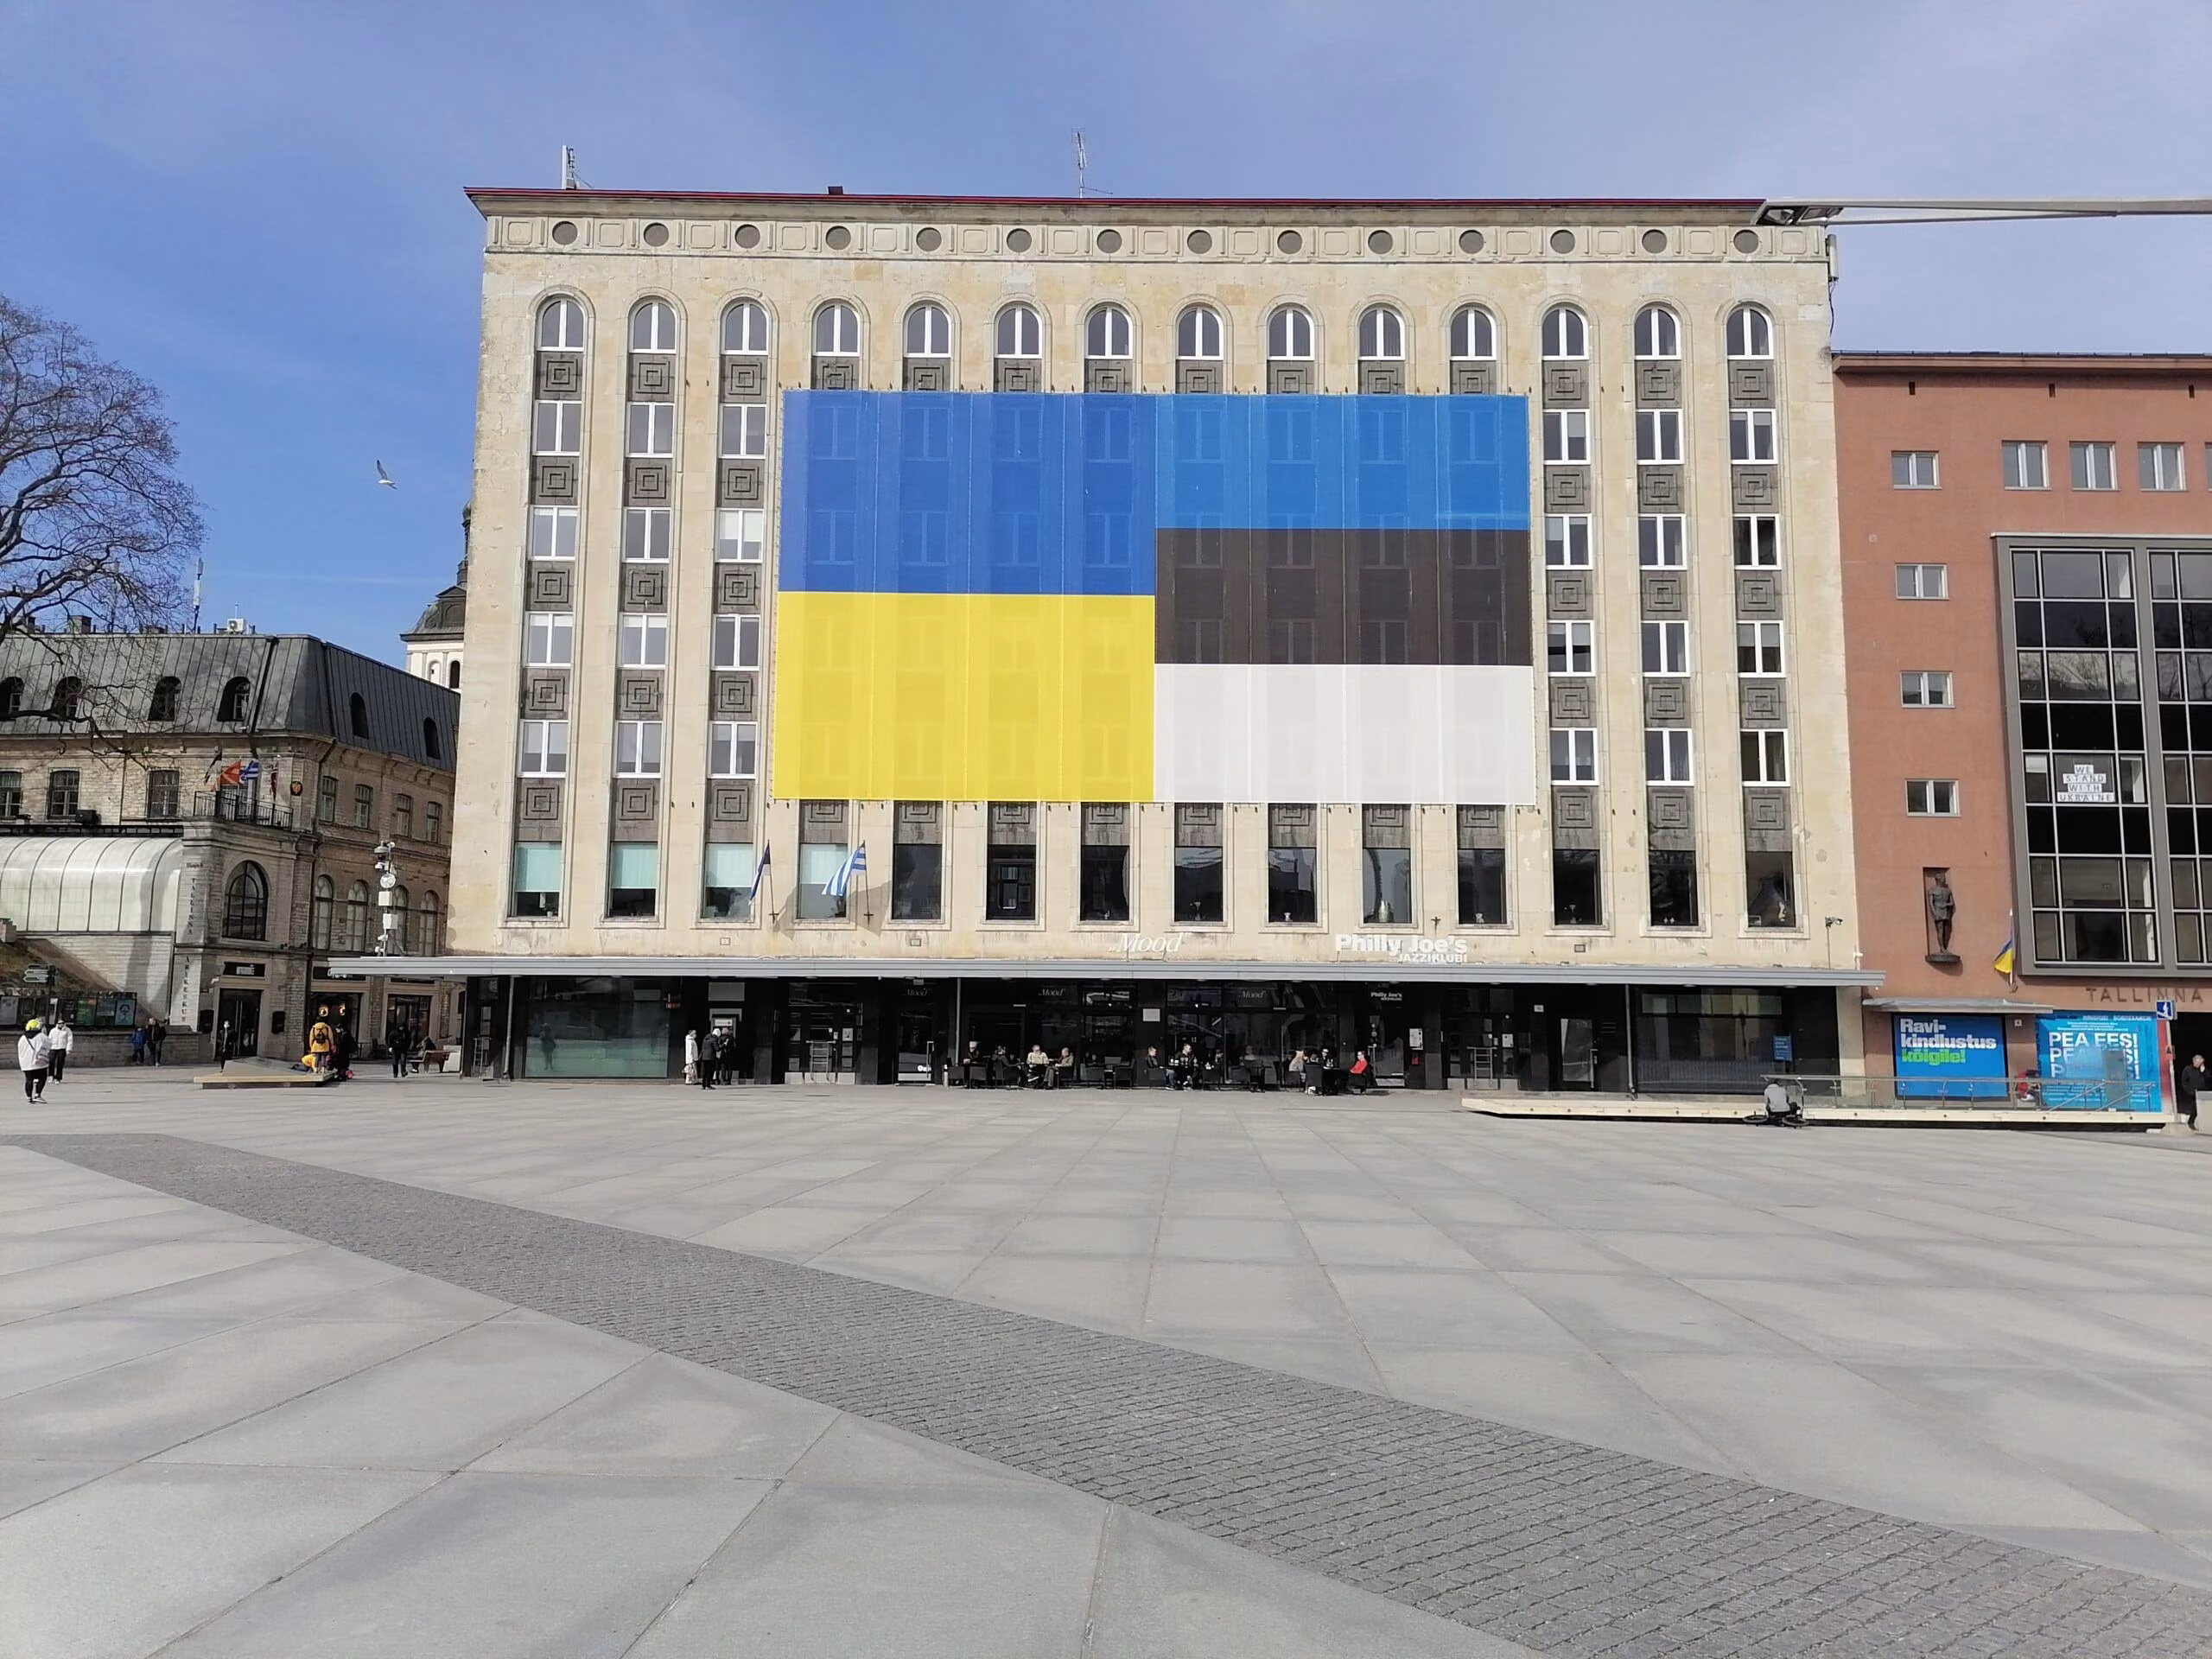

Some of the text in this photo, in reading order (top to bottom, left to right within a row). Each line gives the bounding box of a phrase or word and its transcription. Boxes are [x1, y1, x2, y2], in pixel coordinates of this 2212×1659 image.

[2066, 774, 2104, 783] STAND
[2069, 784, 2101, 792] WITH
[1335, 933, 1468, 957] Philly Joe's
[1397, 953, 1468, 964] JAZZIKLUBI
[2086, 988, 2203, 1003] TALLINNA
[1900, 1018, 1947, 1033] Ravi-
[1901, 1033, 1997, 1049] kindlustus
[2049, 1031, 2089, 1048] PEA
